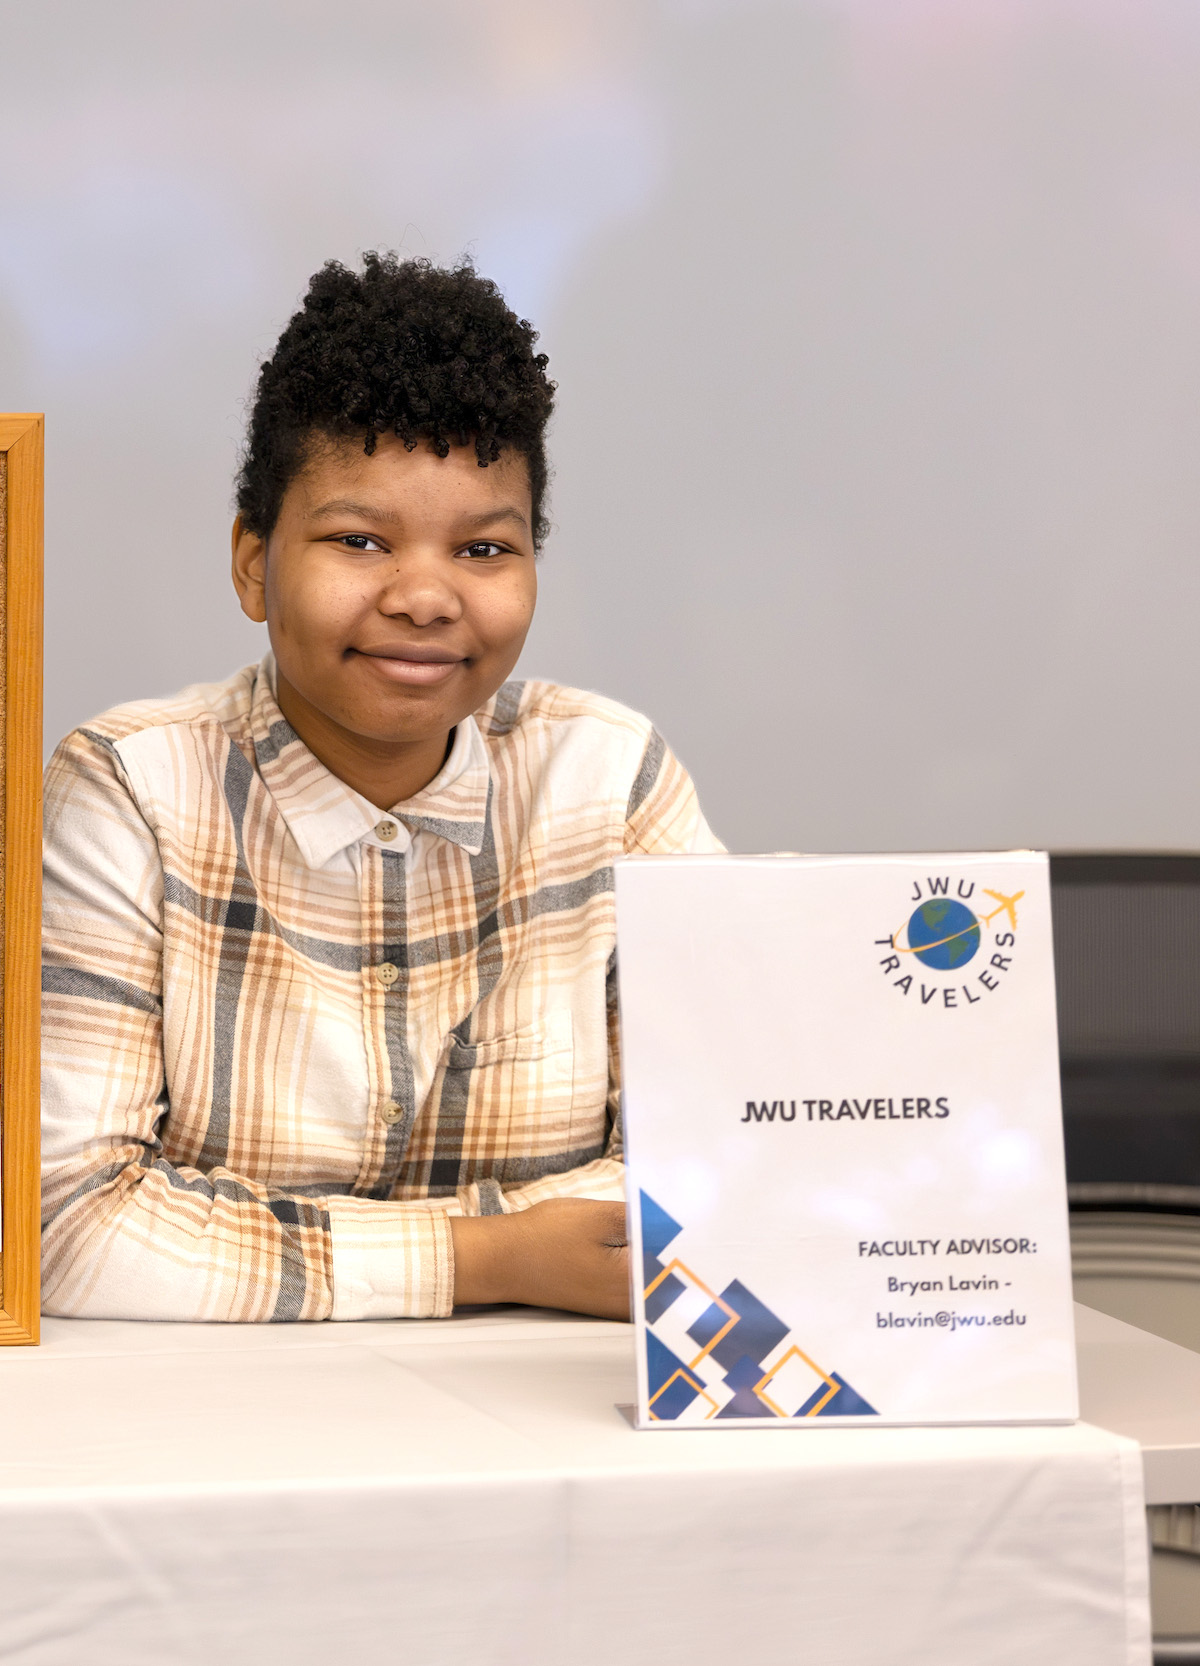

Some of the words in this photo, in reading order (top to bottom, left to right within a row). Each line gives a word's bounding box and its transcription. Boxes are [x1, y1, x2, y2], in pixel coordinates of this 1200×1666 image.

[911, 876, 975, 901] JWU
[875, 933, 1015, 1008] TRAVELERS
[741, 1100, 796, 1122] JWU
[802, 1097, 950, 1121] TRAVELERS
[859, 1240, 940, 1257] FACULTY
[946, 1238, 1037, 1255] ADVISOR:
[888, 1276, 943, 1296] Bryan
[949, 1275, 999, 1291] Lavin
[876, 1309, 1026, 1331] blavin@jwu.edu
